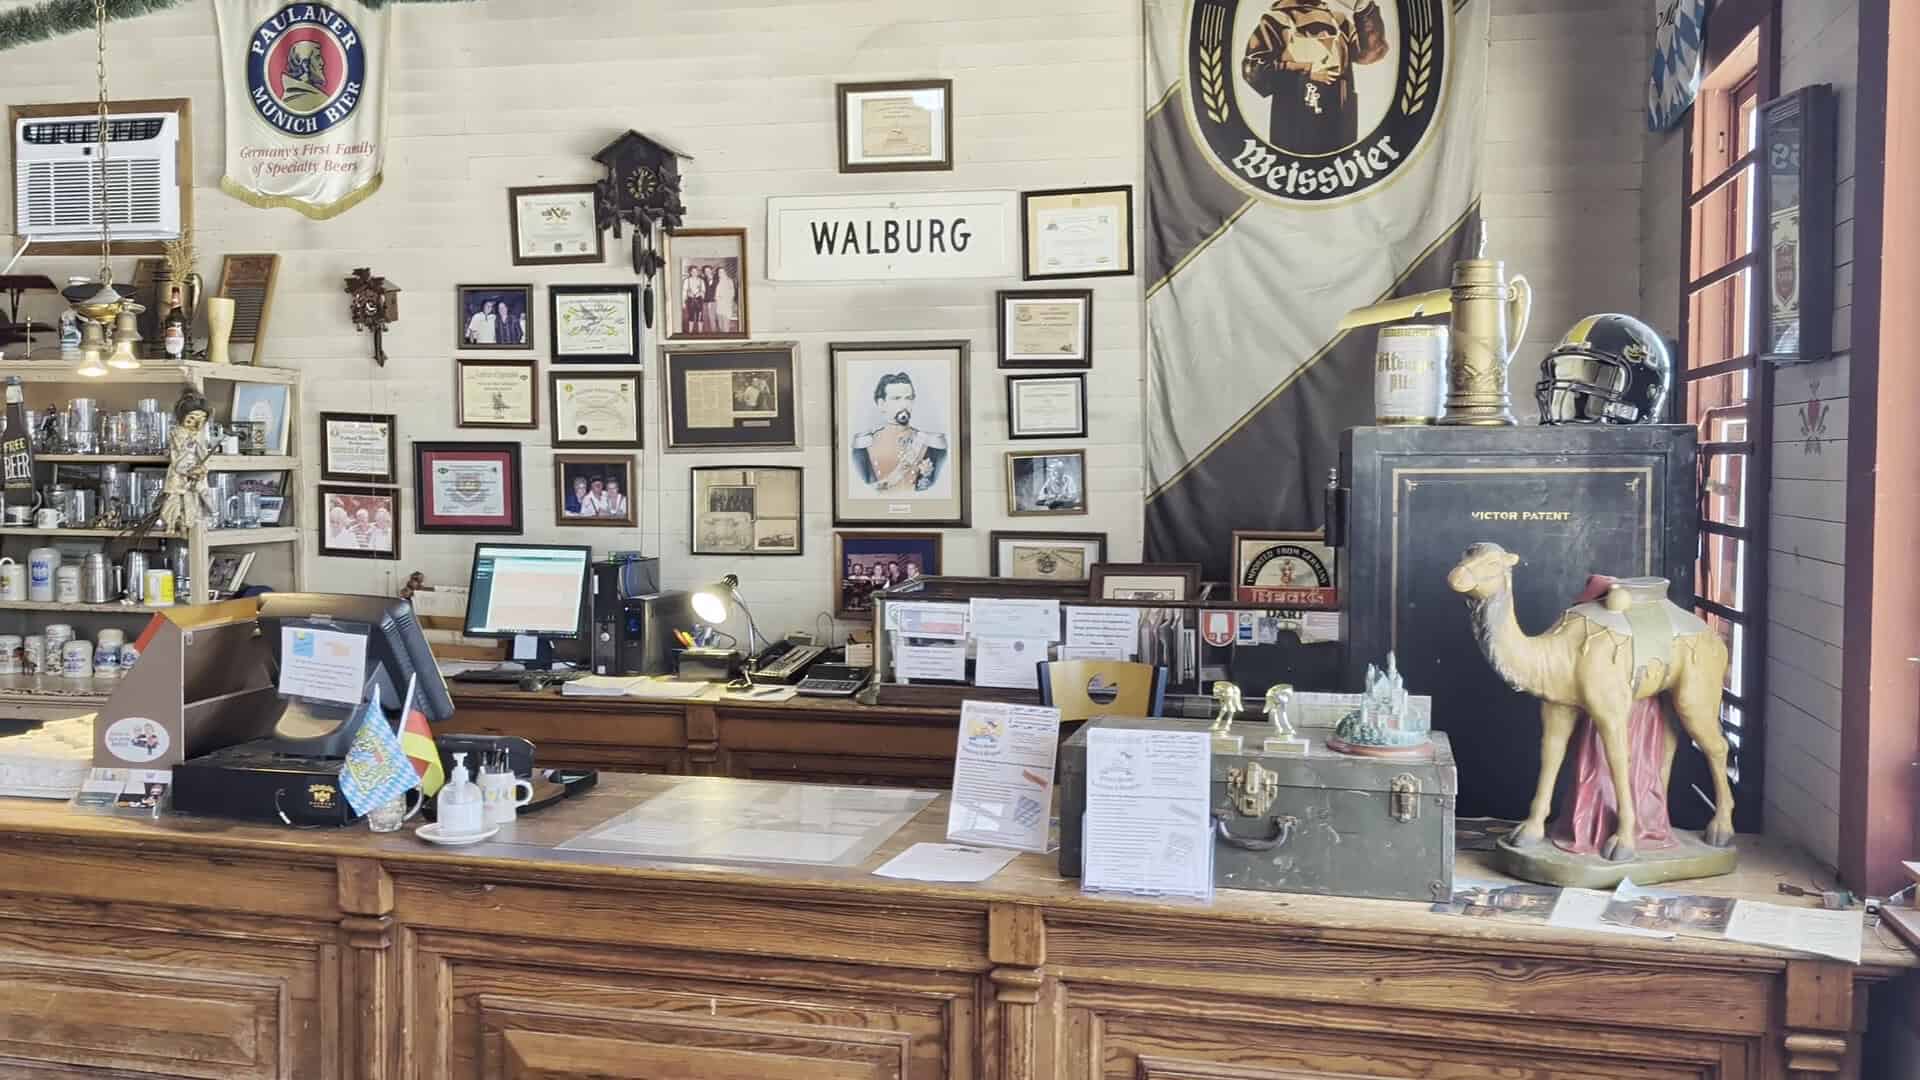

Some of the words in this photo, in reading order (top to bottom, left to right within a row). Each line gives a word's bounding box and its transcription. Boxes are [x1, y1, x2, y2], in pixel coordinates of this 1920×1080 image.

[251, 5, 357, 56] PAULANER
[252, 85, 318, 133] MUNICH
[323, 81, 361, 123] BIER
[239, 144, 299, 160] Germany's
[302, 143, 330, 155] First
[335, 141, 377, 157] Family
[253, 162, 265, 178] of
[266, 161, 320, 178] Specialty
[323, 160, 359, 175] Beers
[1231, 135, 1400, 195] Weissbier
[810, 217, 972, 256] WALBURG
[3, 437, 26, 456] FREE
[4, 453, 32, 480] BEER
[1471, 511, 1518, 521] VICTOR
[1522, 511, 1571, 521] PATENT
